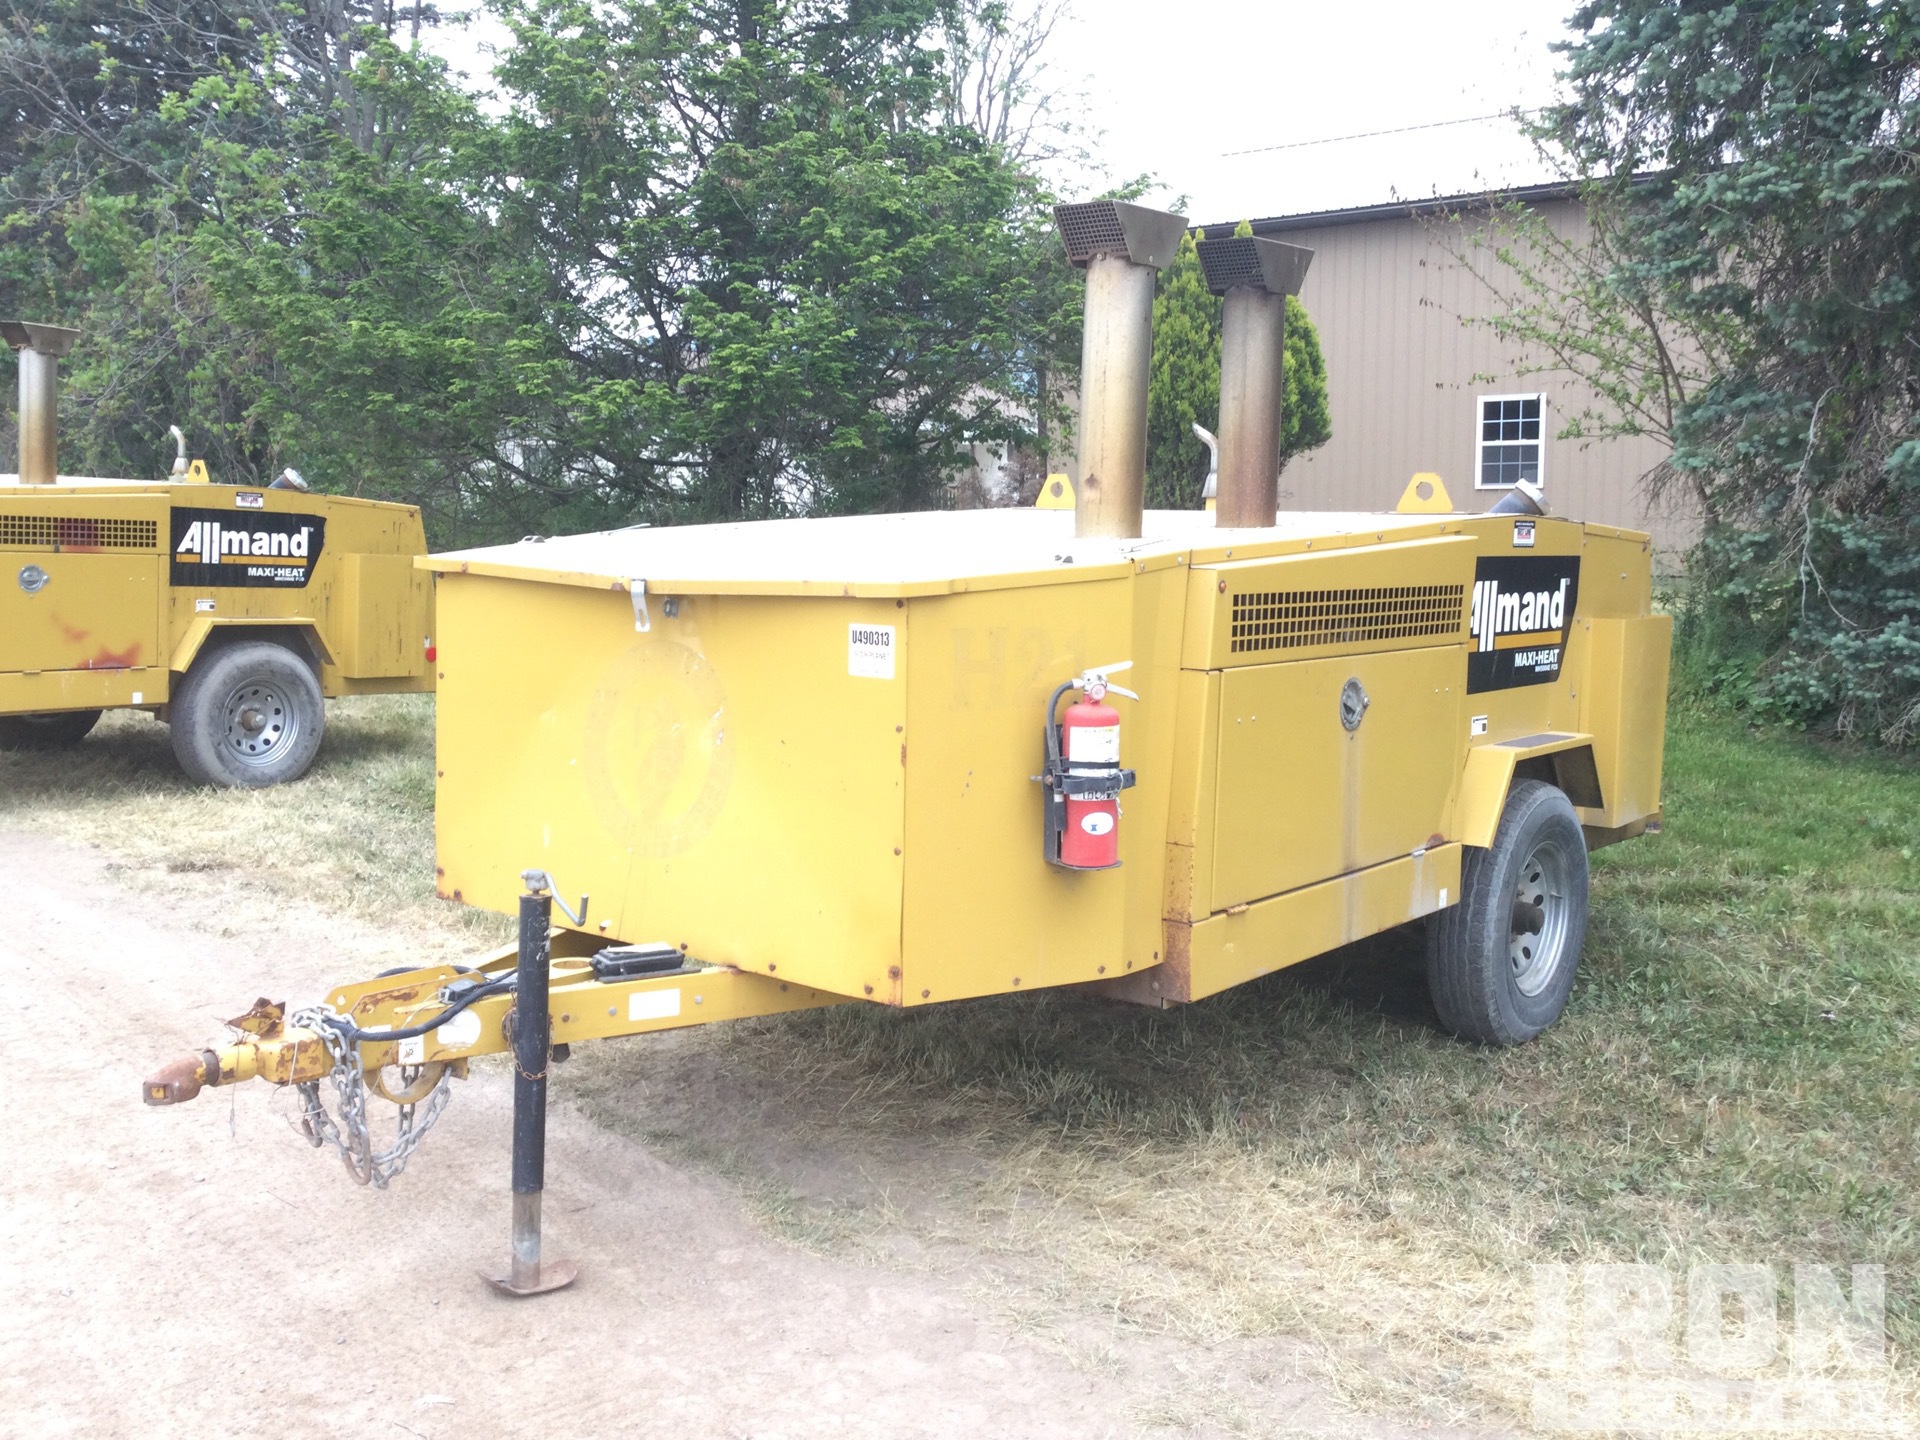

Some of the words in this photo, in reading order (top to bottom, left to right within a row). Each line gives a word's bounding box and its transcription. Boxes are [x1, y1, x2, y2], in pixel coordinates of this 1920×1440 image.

[177, 521, 309, 564] Allmand
[247, 567, 305, 577] MAXI-HEAT
[852, 629, 890, 647] U490313
[1514, 649, 1560, 667] MAXI-HEAT
